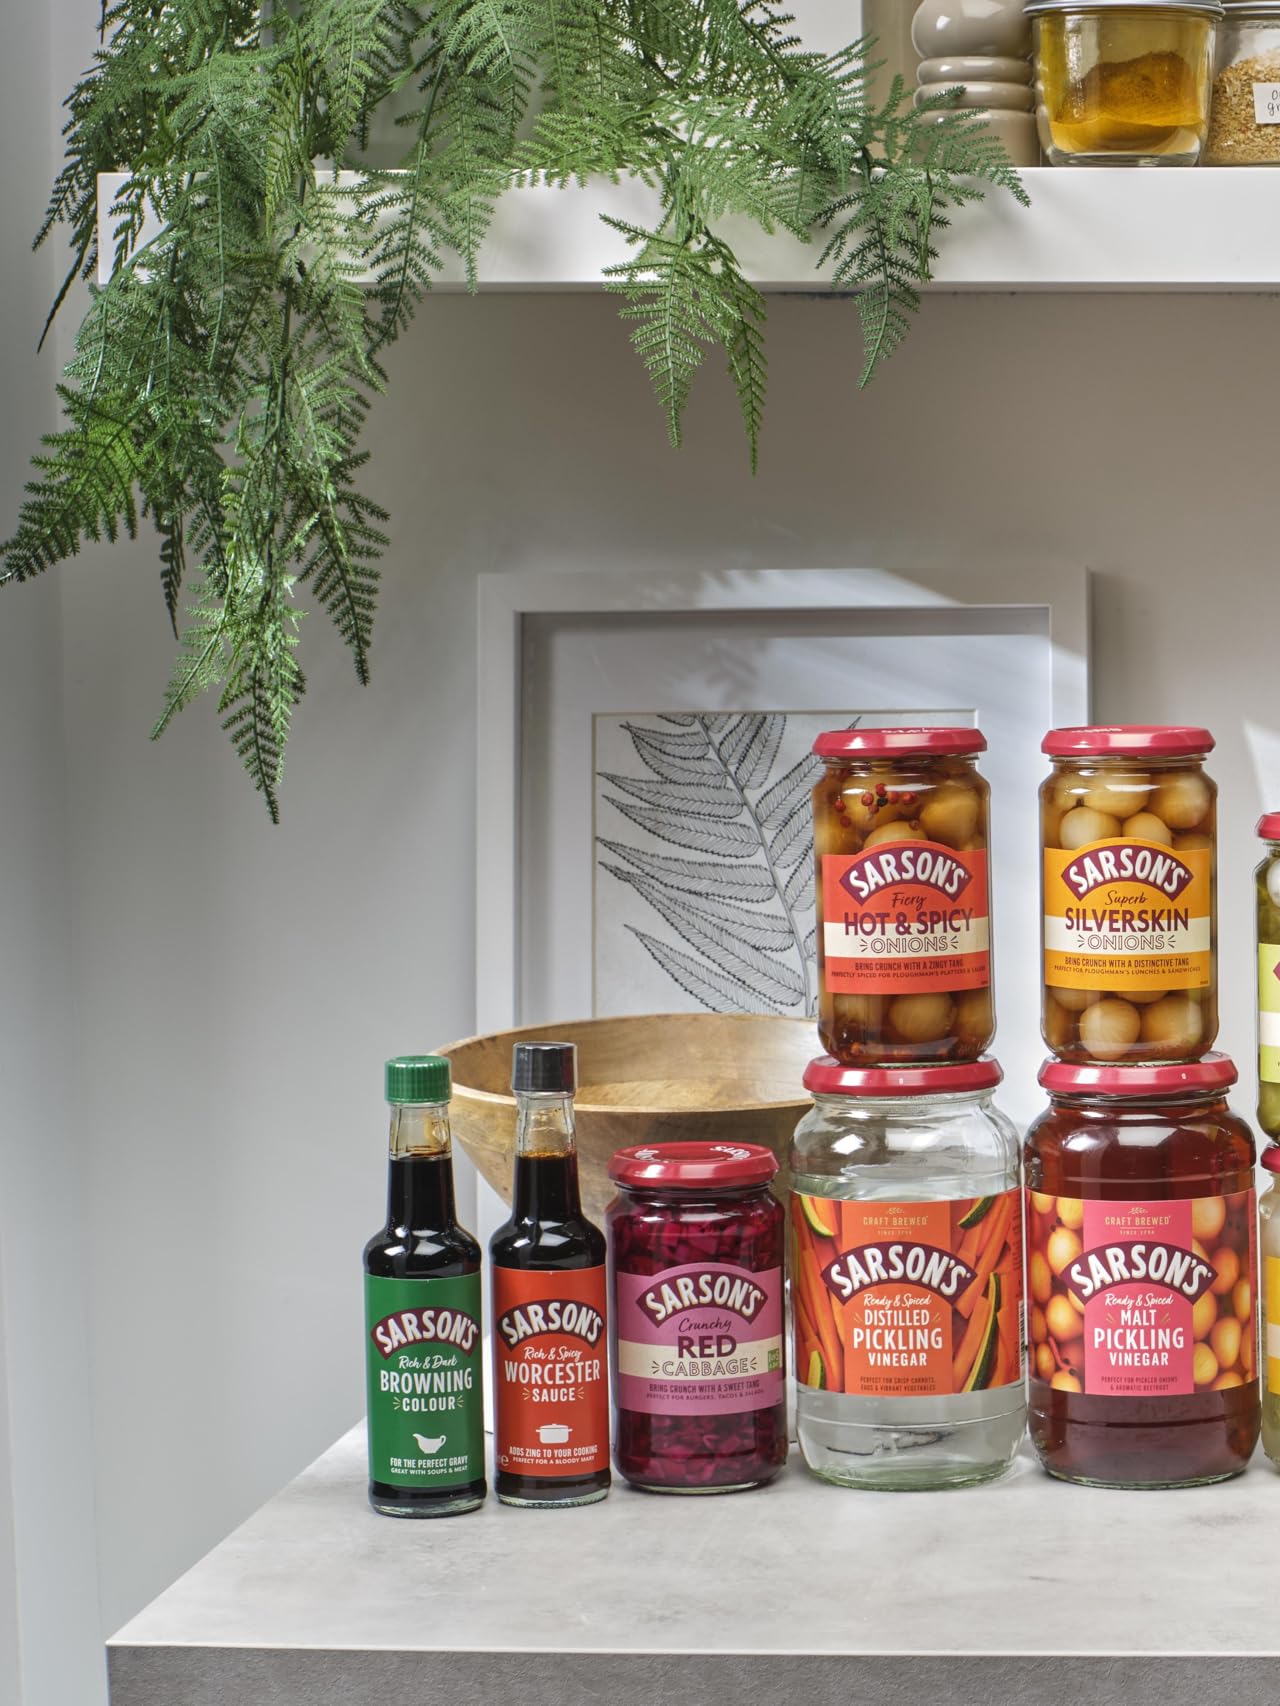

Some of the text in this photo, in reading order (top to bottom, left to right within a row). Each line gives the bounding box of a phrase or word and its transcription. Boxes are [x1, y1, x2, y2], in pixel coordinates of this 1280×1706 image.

[849, 850, 964, 899] SARSON'S
[1069, 848, 1185, 893] SARSON'S
[892, 892, 927, 911] Fiery
[1105, 890, 1147, 907] Superb
[844, 908, 973, 936] HOT & SPICY
[1065, 907, 1188, 932] SILVERSKIN
[871, 936, 948, 953] ONIONS
[1088, 934, 1165, 950] ONIONS
[855, 962, 873, 971] BRING
[875, 962, 900, 971] CRUNCH
[904, 961, 920, 970] WITH
[929, 960, 947, 969] ZINGY
[949, 958, 963, 967] TANG
[1065, 956, 1080, 965] BRING
[1082, 958, 1107, 967] CRUNCH
[1109, 959, 1126, 967] WITH
[1134, 958, 1173, 967] DISTINCTIVE
[1175, 958, 1189, 966] TANG
[863, 1217, 927, 1226] CRAFT BREWED
[1105, 1217, 1169, 1225] CRAFT BREWED
[830, 1245, 967, 1297] SARSON'S
[1070, 1244, 1208, 1297] SARSON'S
[645, 1274, 761, 1320] SARSON'S
[864, 1293, 893, 1309] Ready
[902, 1293, 931, 1307] Spiced
[1105, 1292, 1134, 1309] Ready
[1143, 1293, 1173, 1307] Spiced
[502, 1302, 602, 1345] SARSON'S
[678, 1317, 731, 1333] Crunchy
[864, 1310, 930, 1326] DISTILLED
[1121, 1309, 1157, 1326] MALT
[376, 1310, 478, 1353] SARSON'S
[853, 1328, 942, 1349] PICKLING
[1094, 1328, 1184, 1349] PICKLING
[524, 1347, 546, 1359] Rich
[557, 1346, 582, 1362] Spicy
[677, 1335, 737, 1359] RED
[398, 1354, 457, 1369] Rich & Dark
[662, 1358, 748, 1376] CABBAGE
[868, 1352, 927, 1366] VINEGAR
[1109, 1352, 1168, 1366] VINEGAR
[505, 1360, 600, 1384] WORCESTER
[380, 1368, 472, 1394] BROWNING
[650, 1383, 667, 1392] BRING
[670, 1385, 696, 1393] CRUNCH
[699, 1385, 715, 1393] WITH
[724, 1383, 744, 1392] SWEET
[745, 1380, 759, 1389] TANG
[532, 1387, 575, 1402] SAUCE
[402, 1397, 455, 1412] COLOUR
[509, 1445, 597, 1457] ADDS ZING TO YOUR COOKING
[390, 1456, 468, 1468] FOR THE PERFECT GRAVY
